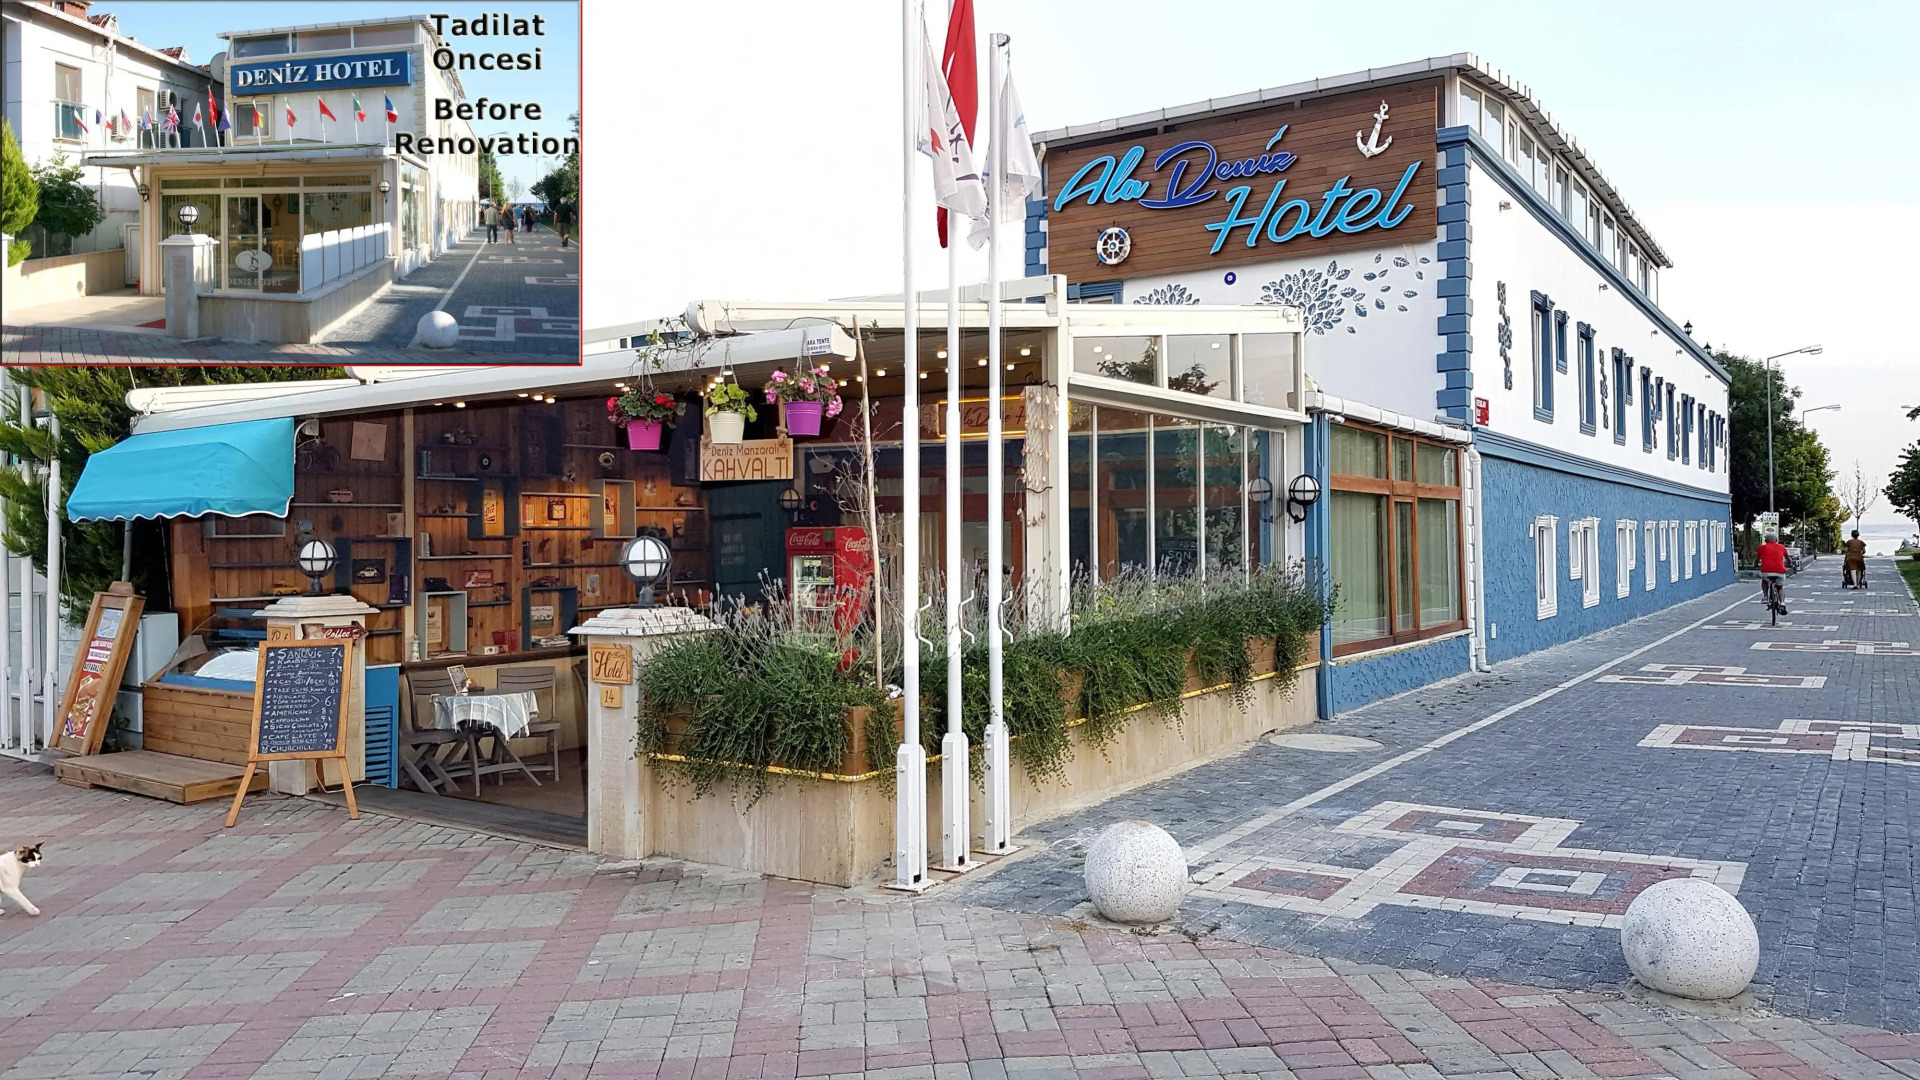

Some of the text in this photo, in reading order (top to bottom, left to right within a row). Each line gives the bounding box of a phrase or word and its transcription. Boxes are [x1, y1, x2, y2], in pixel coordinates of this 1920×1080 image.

[237, 58, 400, 87] DENİZ HOTEL
[1054, 124, 1297, 212] Ala Deniz
[1205, 161, 1423, 255] Hotel
[711, 444, 733, 457] Deniz
[702, 456, 788, 480] KAHVALTI
[324, 628, 351, 640] Coffee
[594, 650, 626, 679] Hotel
[604, 689, 615, 704] 14
